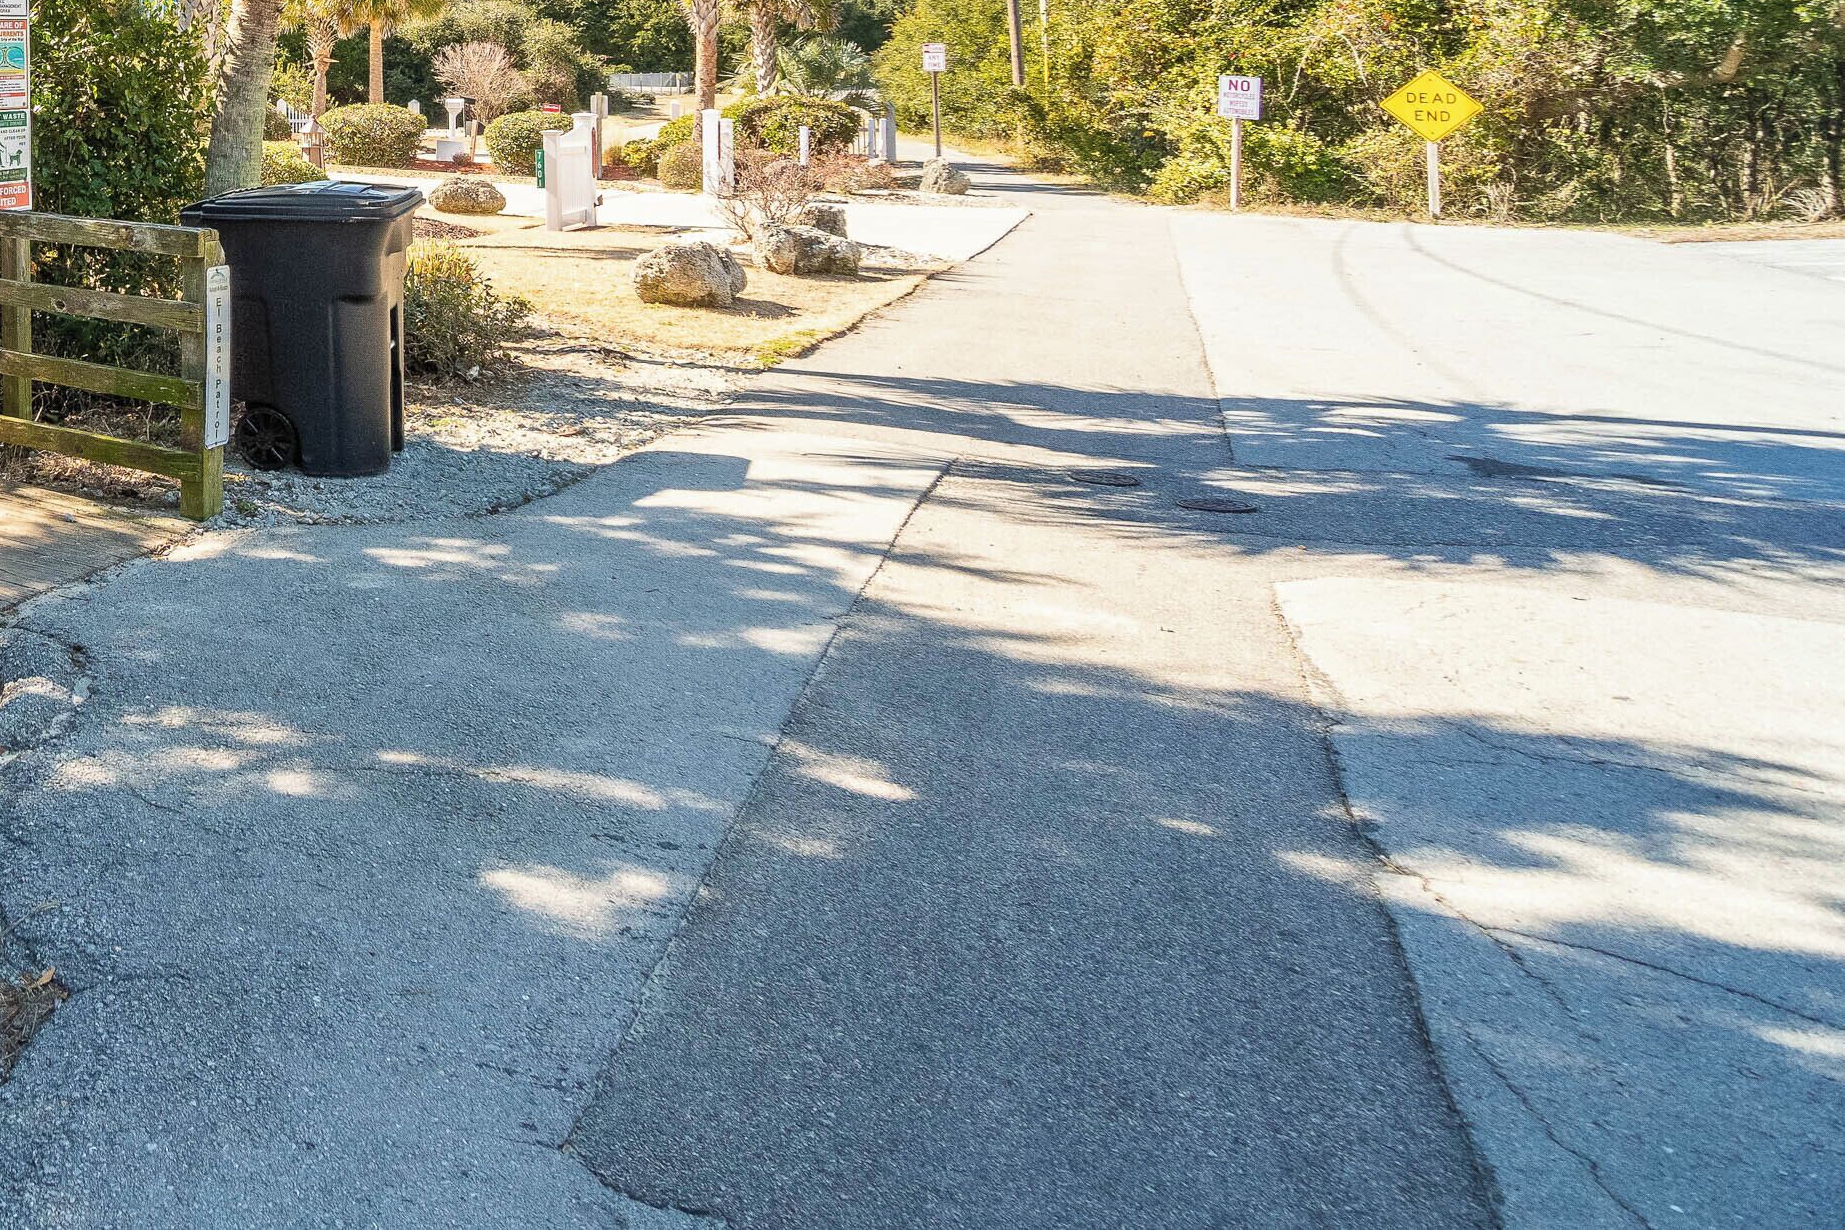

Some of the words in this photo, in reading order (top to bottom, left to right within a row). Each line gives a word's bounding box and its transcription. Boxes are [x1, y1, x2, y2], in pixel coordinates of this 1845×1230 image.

[1229, 80, 1250, 91] NO
[1407, 92, 1457, 104] DEAD
[1414, 110, 1451, 122] END
[214, 378, 222, 439] Patrol
